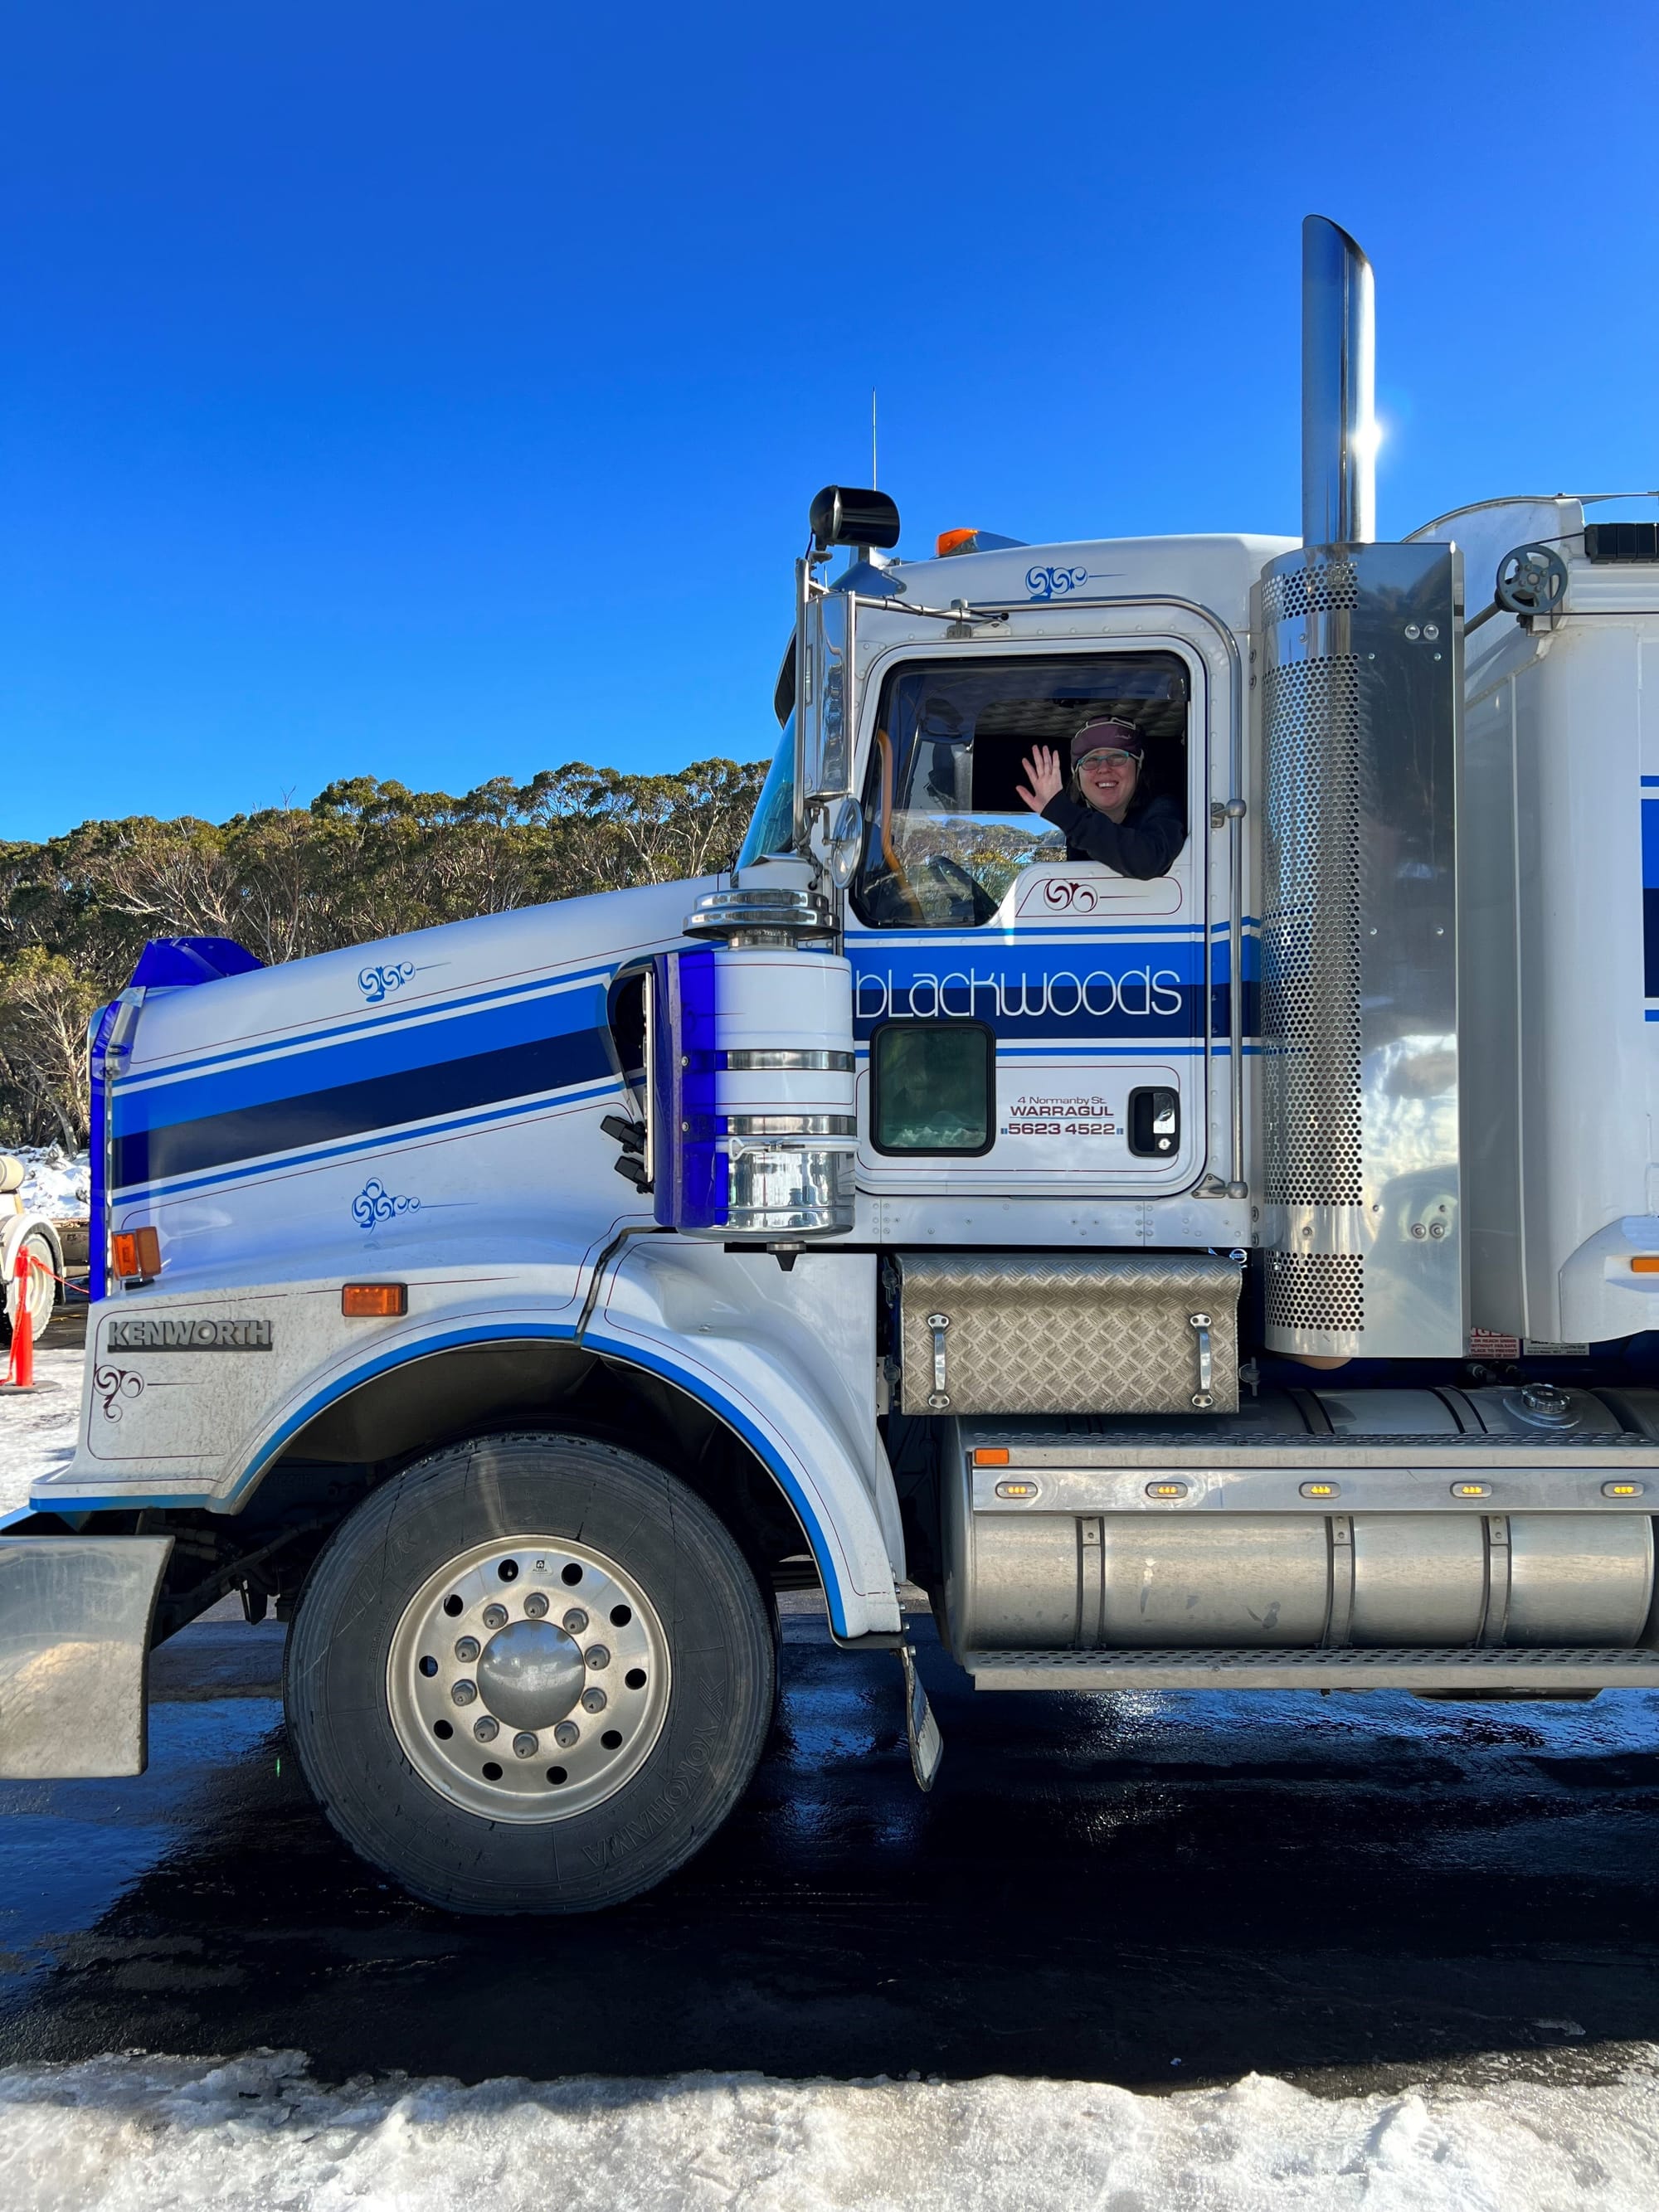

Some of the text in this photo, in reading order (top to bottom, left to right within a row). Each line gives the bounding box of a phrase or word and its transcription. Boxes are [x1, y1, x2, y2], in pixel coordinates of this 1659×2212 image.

[1029, 1096, 1089, 1106] Normanby
[1010, 1106, 1115, 1116] WARRAGUL
[1008, 1123, 1116, 1135] 5623 4522
[109, 1320, 271, 1345] KENWORTH
[581, 1725, 719, 1867] YOKOHAMA
